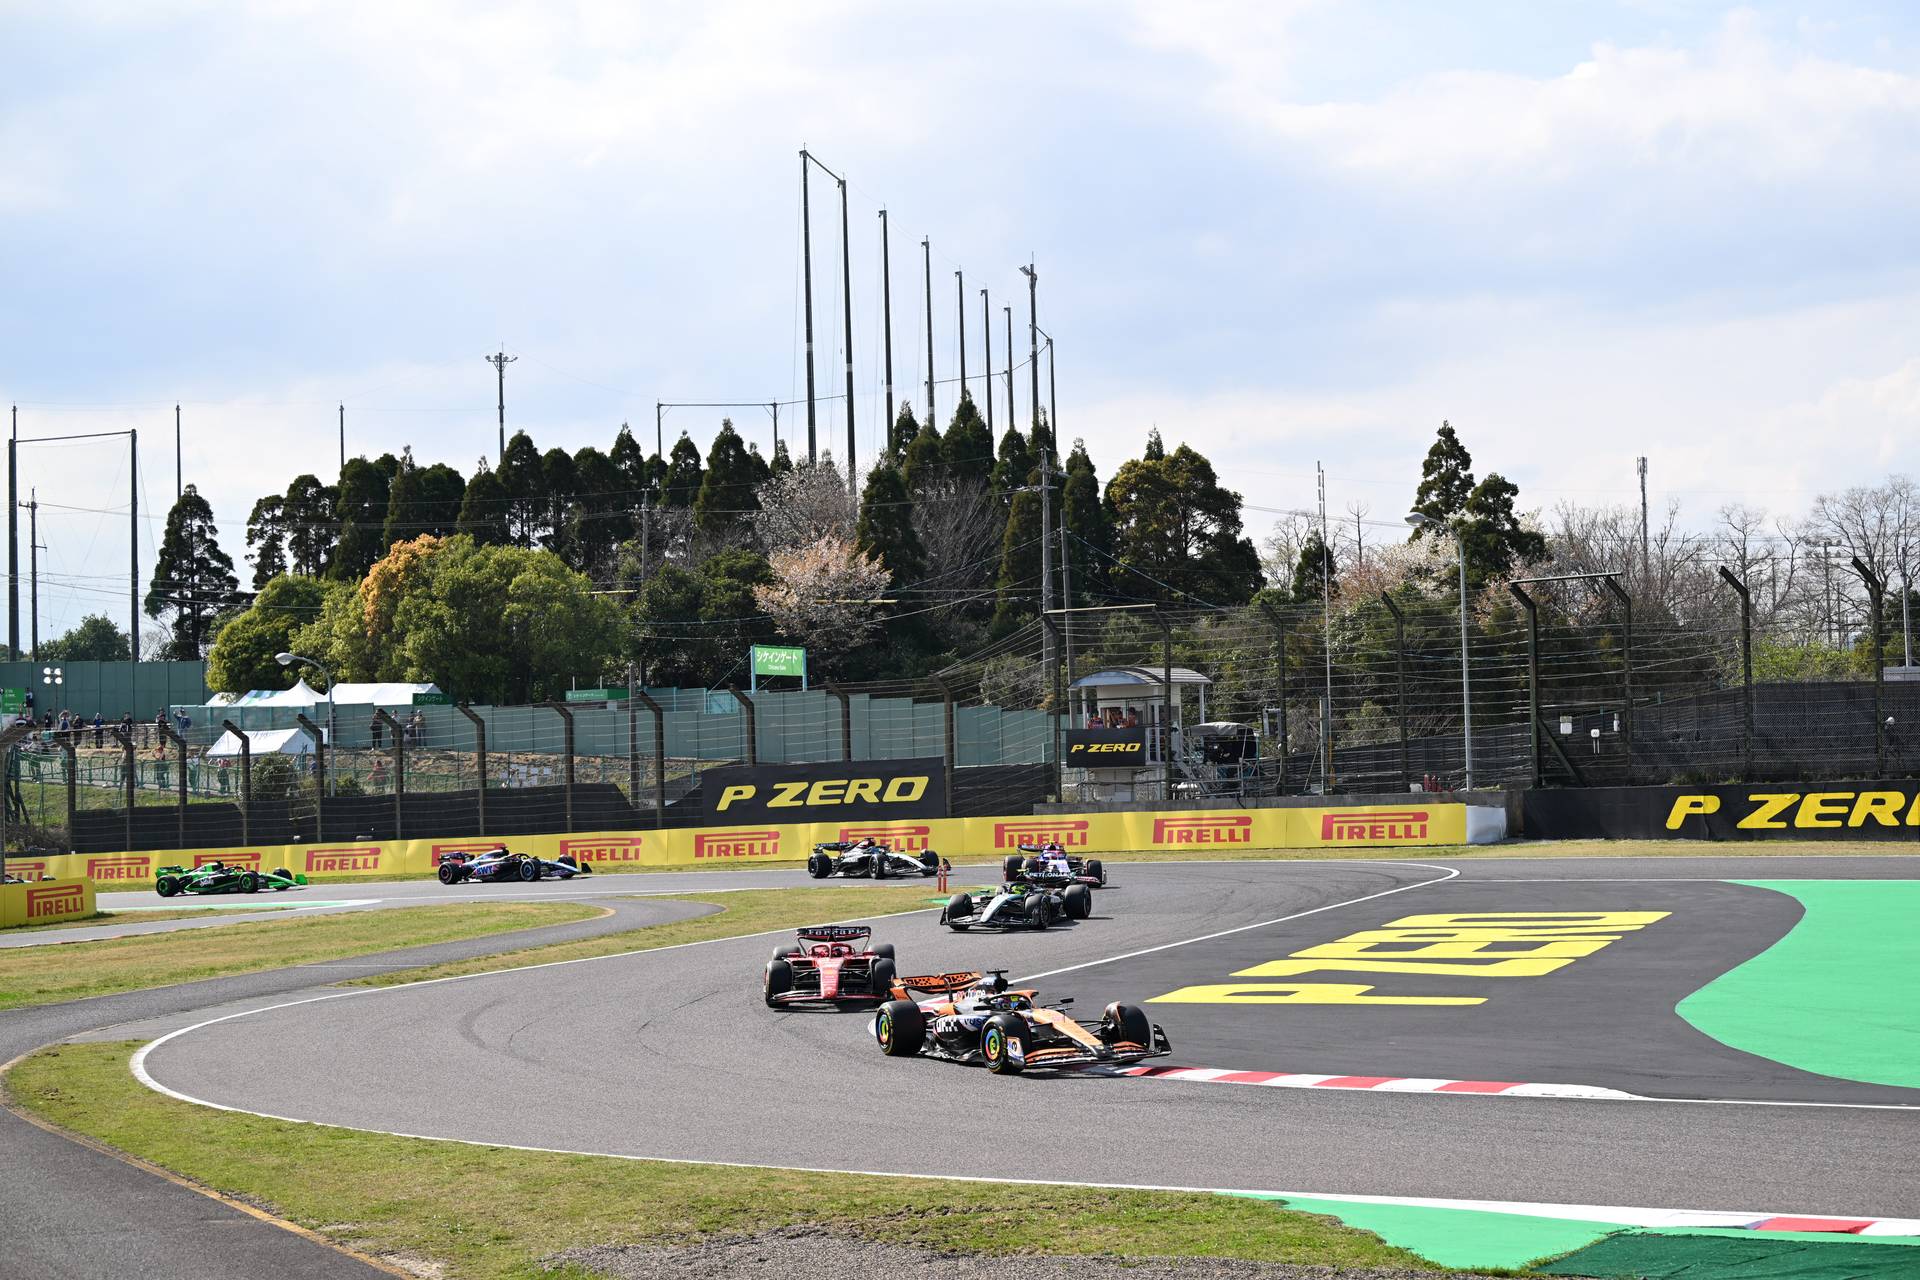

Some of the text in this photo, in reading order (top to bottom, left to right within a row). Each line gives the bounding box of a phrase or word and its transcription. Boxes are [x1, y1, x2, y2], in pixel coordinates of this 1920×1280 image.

[1071, 742, 1141, 753] P ZERO
[717, 776, 929, 811] P ZERO
[1665, 791, 1920, 830] P ZER
[995, 820, 1088, 848] PIRELLI
[1153, 816, 1252, 844] PIRELLI
[1321, 812, 1429, 841] PIRELLI
[560, 837, 642, 862] PIRELLI
[694, 831, 780, 858] PIRELLI
[86, 856, 150, 880] PIRELLI
[306, 847, 381, 872] PIRELLI
[27, 884, 83, 918] PIRELLI
